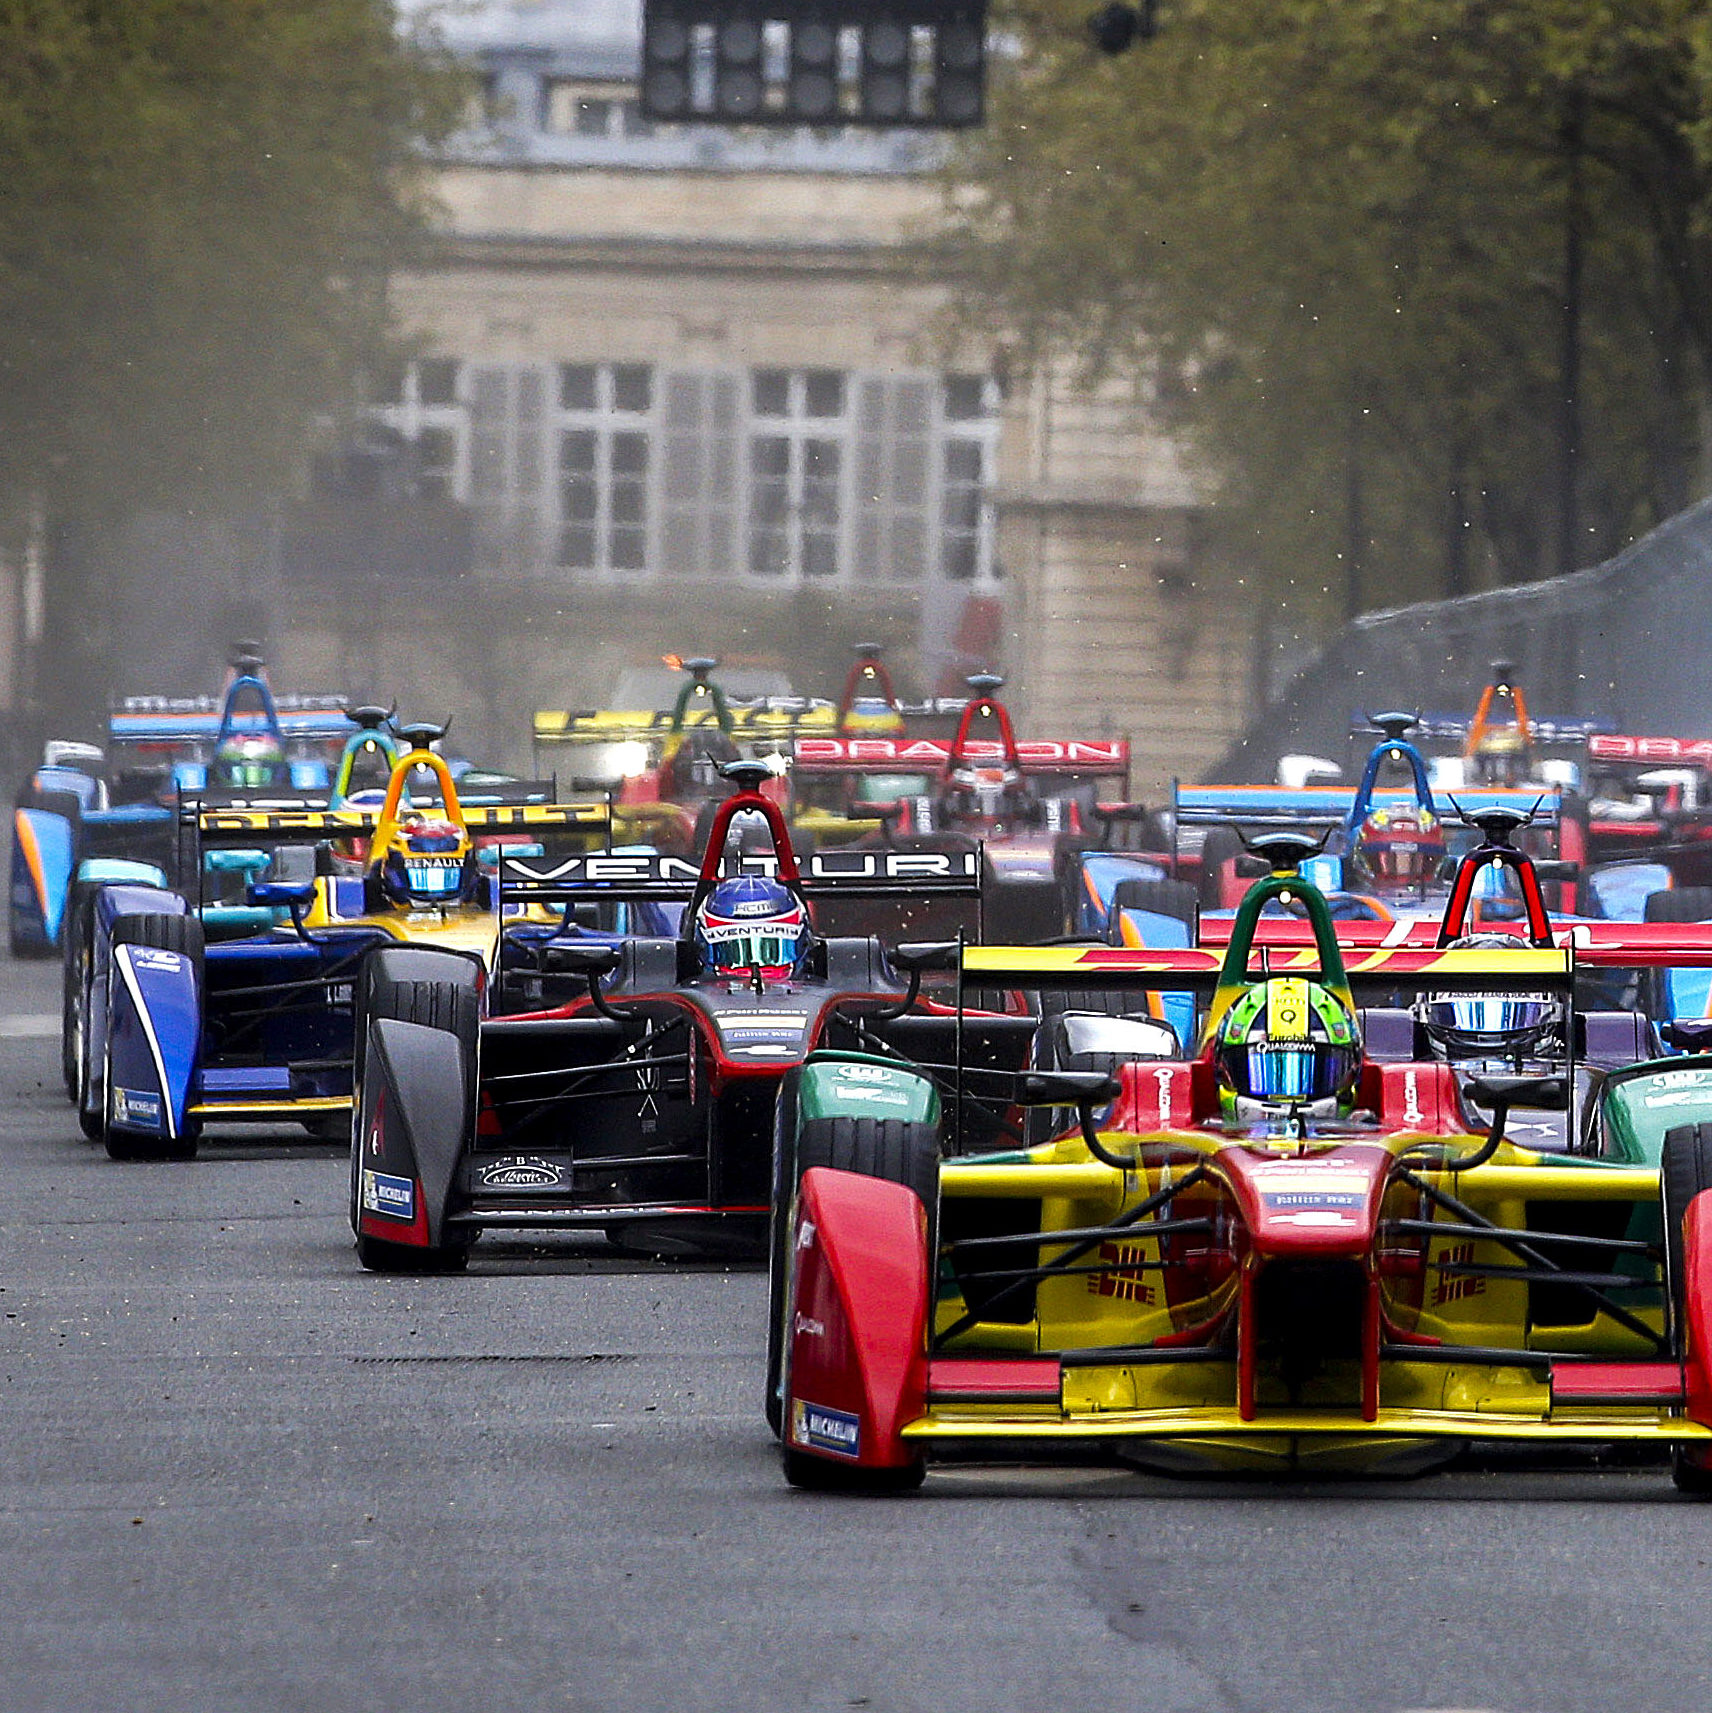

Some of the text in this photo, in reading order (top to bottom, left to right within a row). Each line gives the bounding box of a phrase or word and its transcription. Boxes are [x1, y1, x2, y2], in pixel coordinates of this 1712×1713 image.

[403, 857, 465, 869] RENAULT
[504, 854, 976, 880] VENTURI
[715, 926, 792, 938] VENTURI
